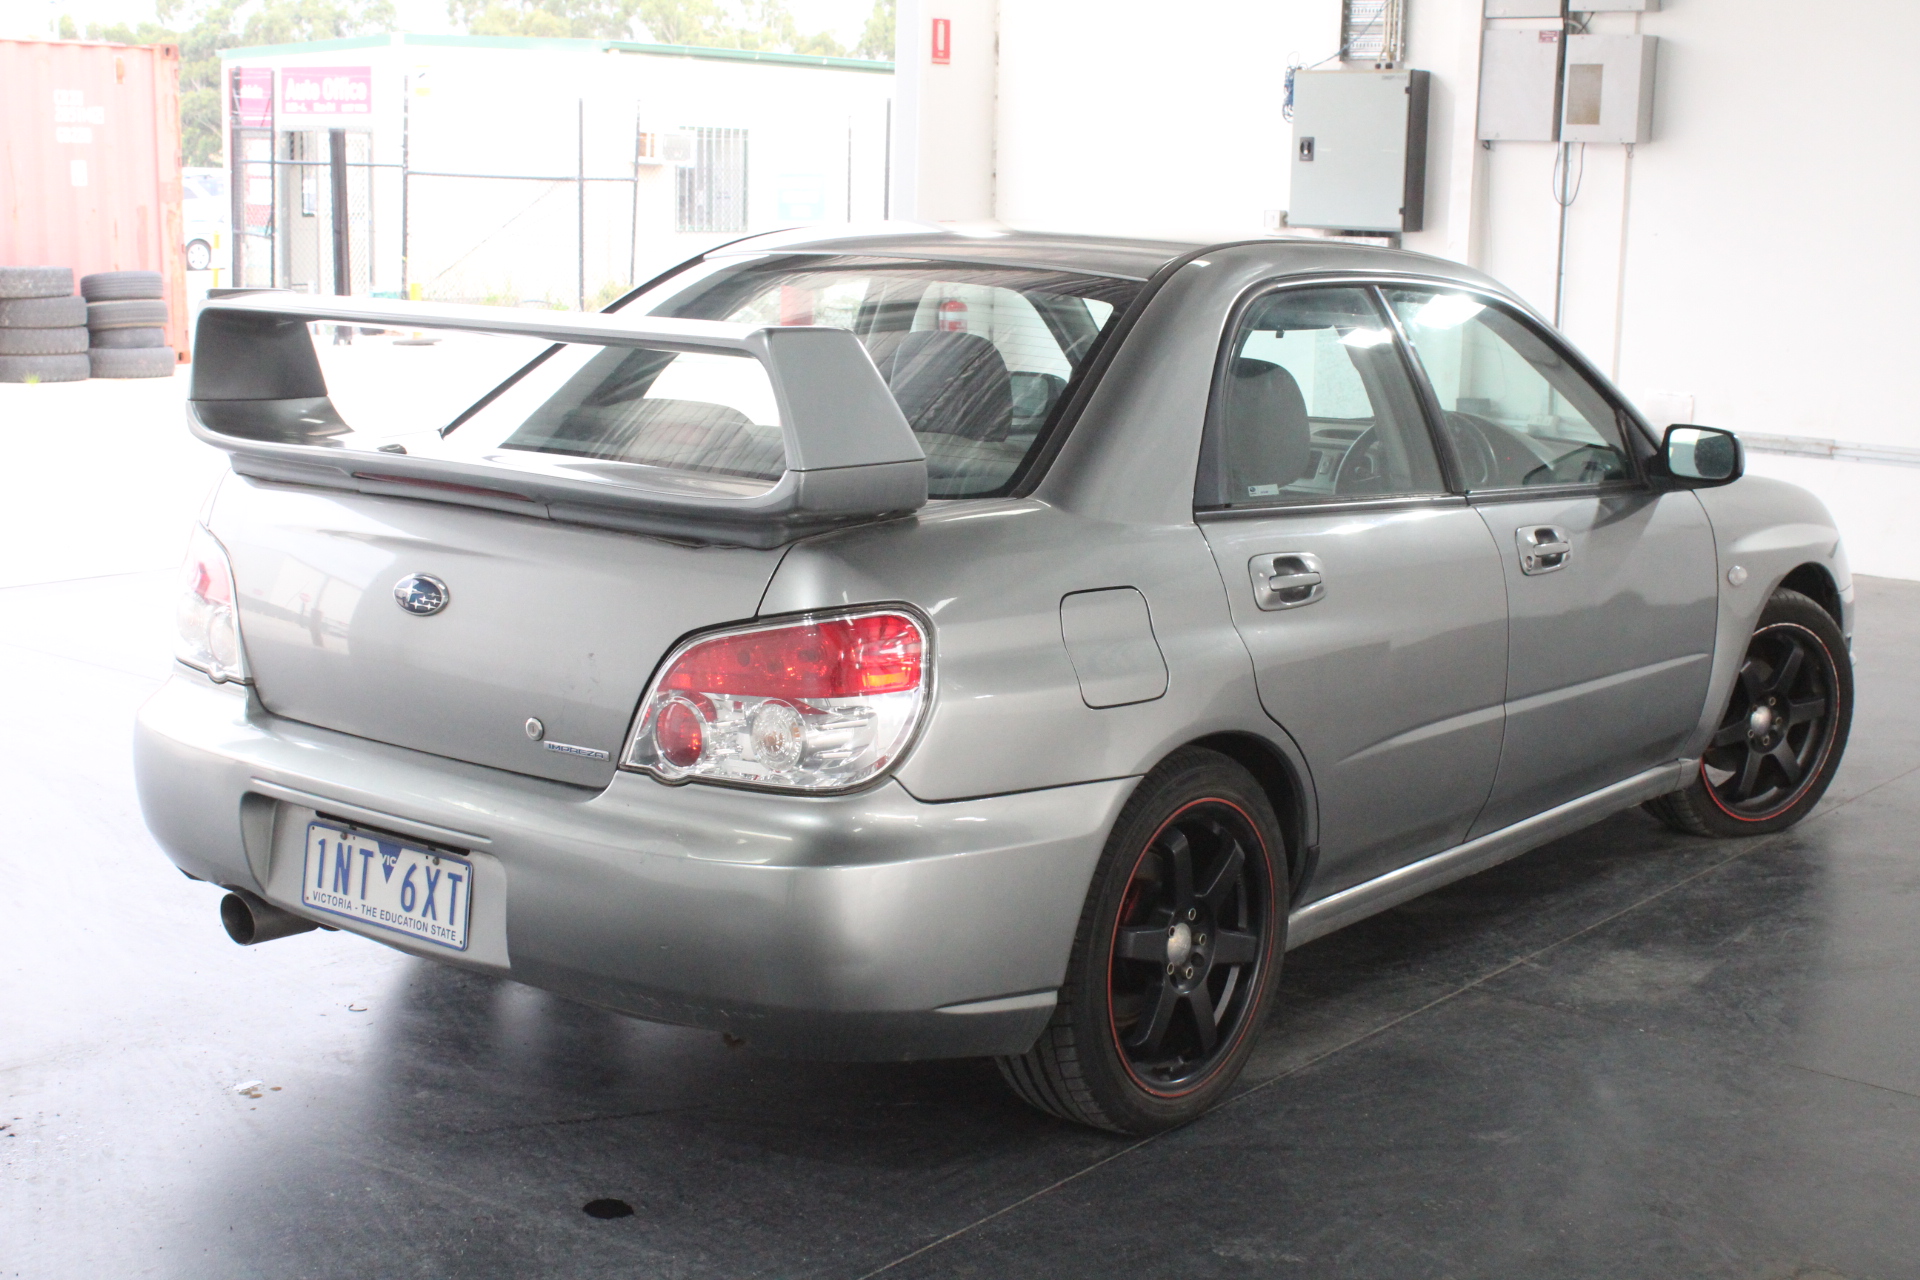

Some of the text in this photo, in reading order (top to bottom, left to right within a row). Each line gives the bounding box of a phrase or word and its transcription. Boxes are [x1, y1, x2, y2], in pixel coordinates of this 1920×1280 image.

[285, 77, 320, 101] Auto
[322, 77, 367, 101] Office
[548, 743, 604, 759] IMPREZA
[382, 854, 398, 867] VIC
[317, 838, 463, 926] 1NT 6XT
[312, 890, 352, 911] VICTORIA
[361, 904, 377, 918] THE
[380, 910, 429, 933] EDUCATION
[431, 925, 457, 941] STATE
